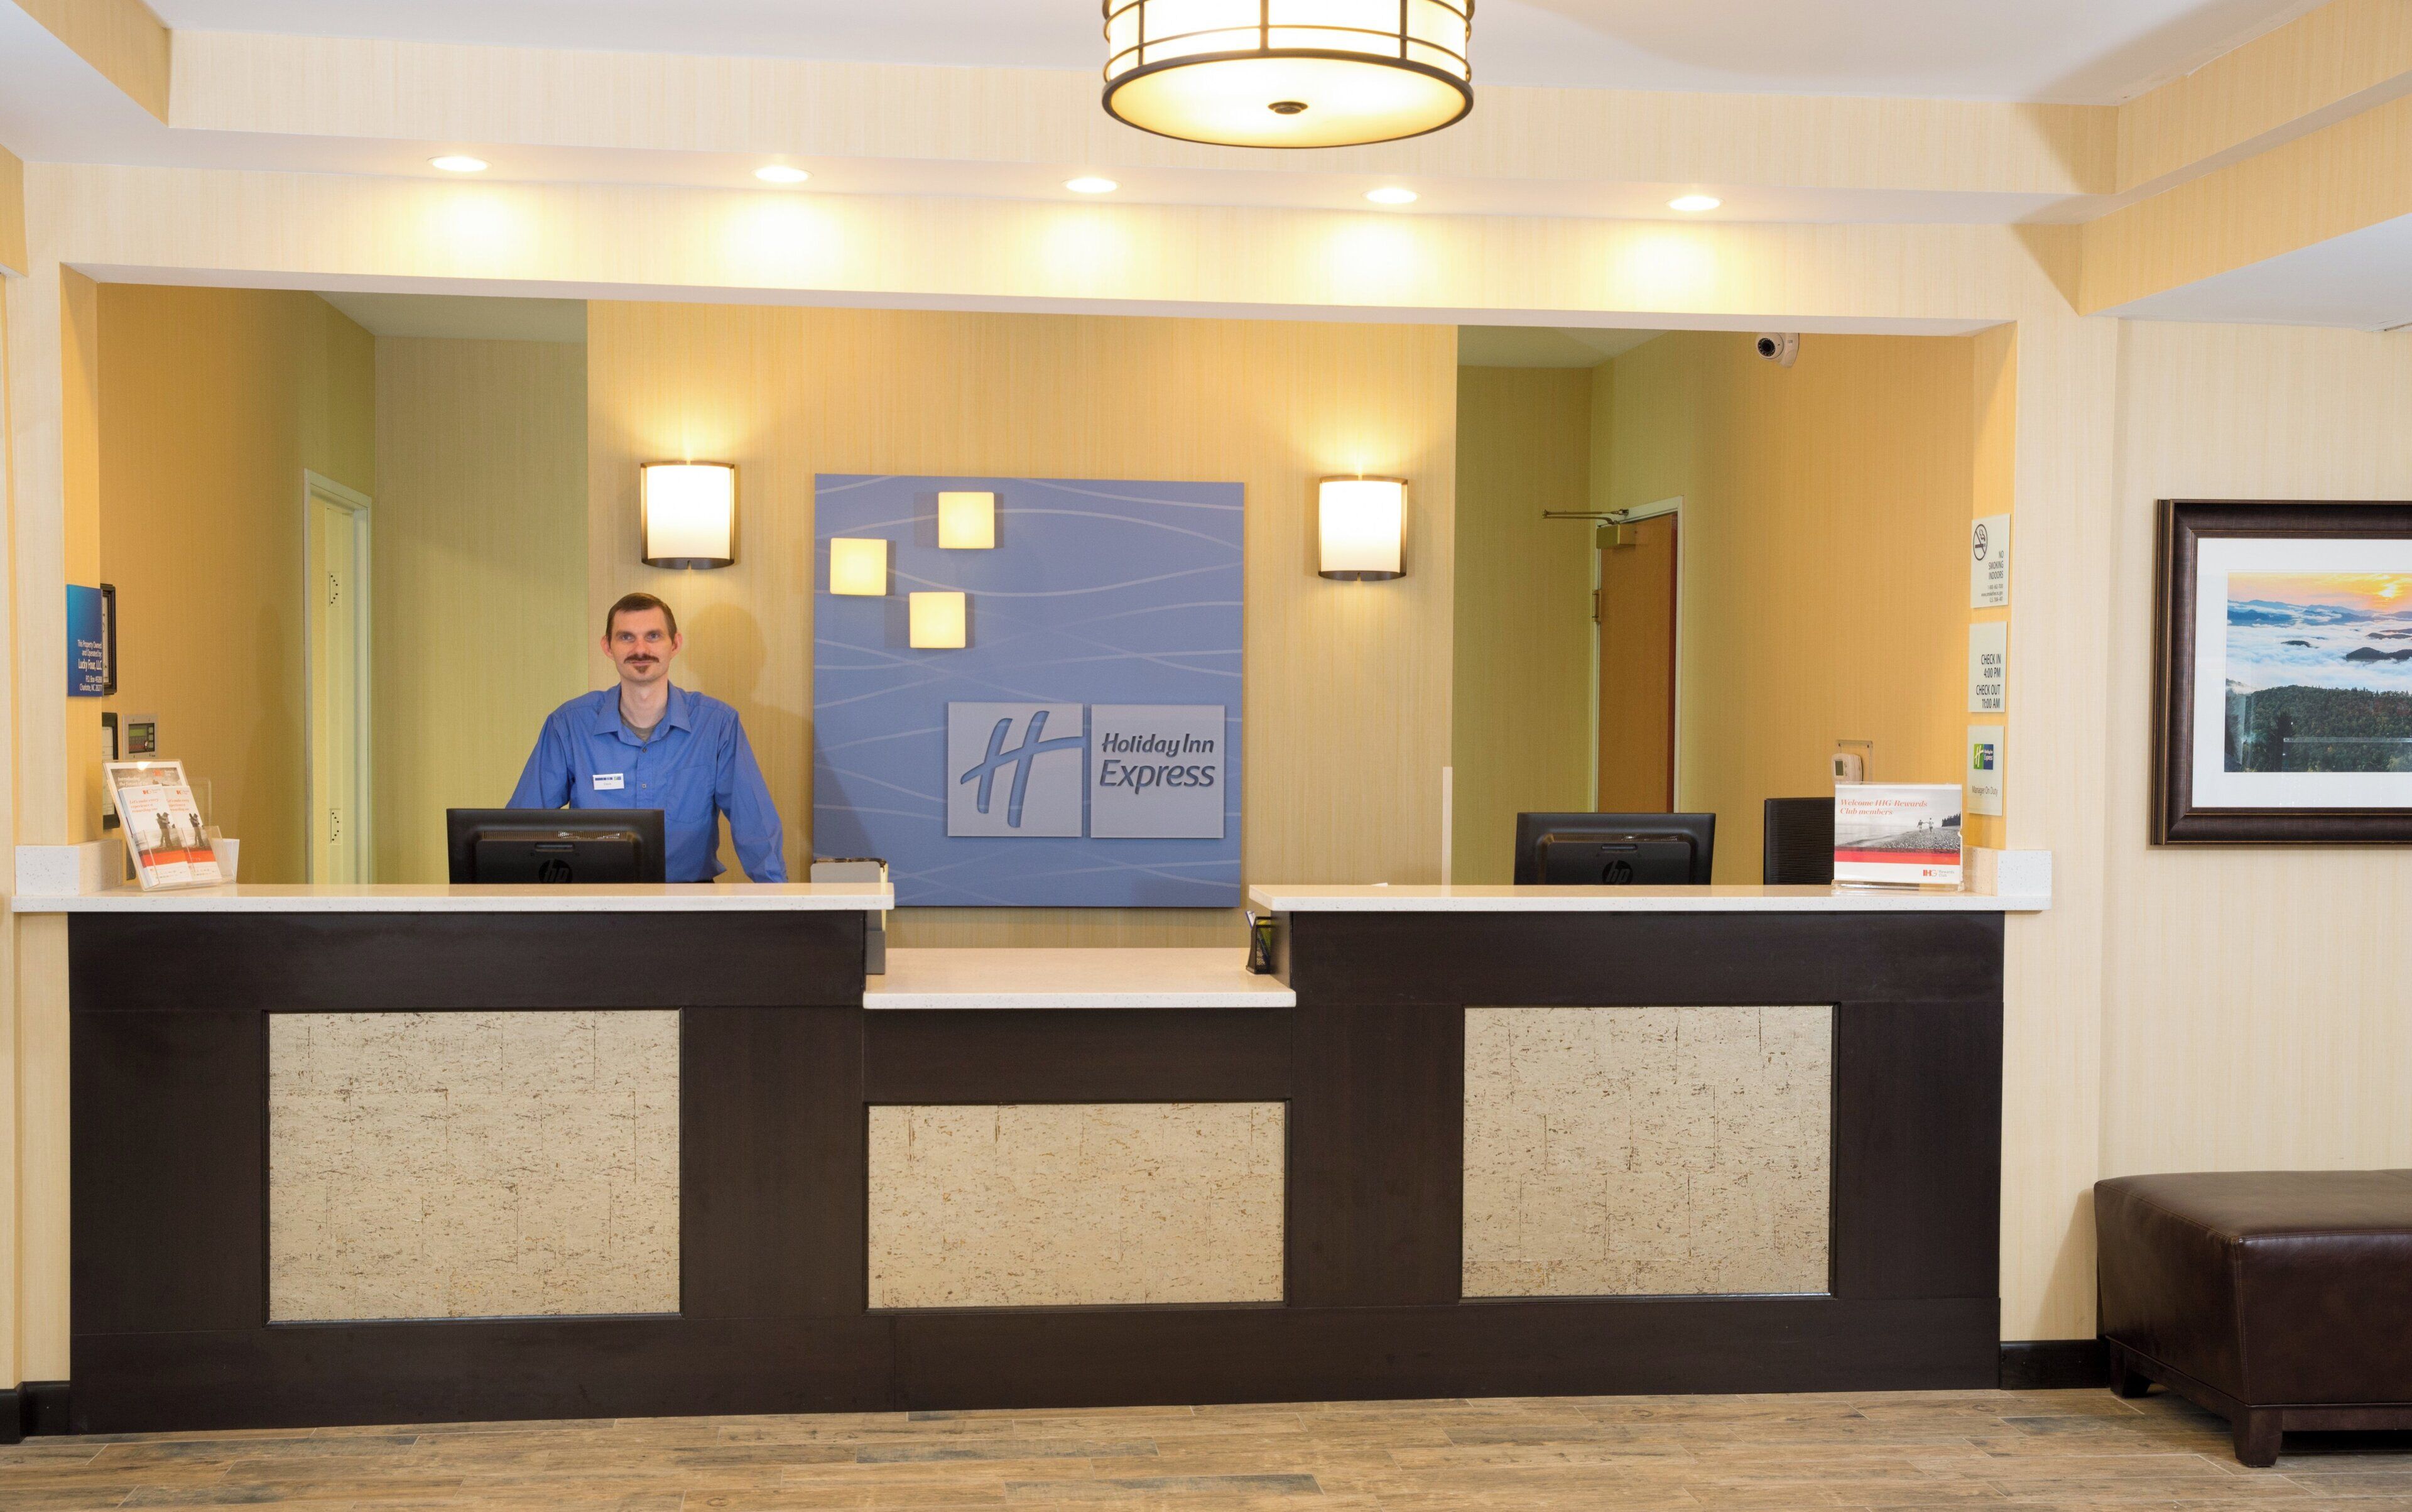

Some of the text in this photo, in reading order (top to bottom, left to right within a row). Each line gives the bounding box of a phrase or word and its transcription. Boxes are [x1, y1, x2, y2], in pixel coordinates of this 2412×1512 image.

[1999, 550, 2004, 558] NO
[1989, 560, 2004, 570] SMOKING
[1989, 570, 2004, 580] INDOORS
[83, 640, 92, 650] Property
[1981, 654, 2001, 665] CHECK IN
[78, 658, 87, 672] Lucky
[1984, 667, 2001, 678] 4:00 PM
[1976, 685, 2000, 695] CHECK OUT
[1982, 698, 2000, 708] 11:00 AM
[1101, 732, 1214, 758] Holiday Inn
[1099, 759, 1216, 795] Express
[1972, 786, 1984, 795] Manager
[1840, 799, 1874, 807] Welcome
